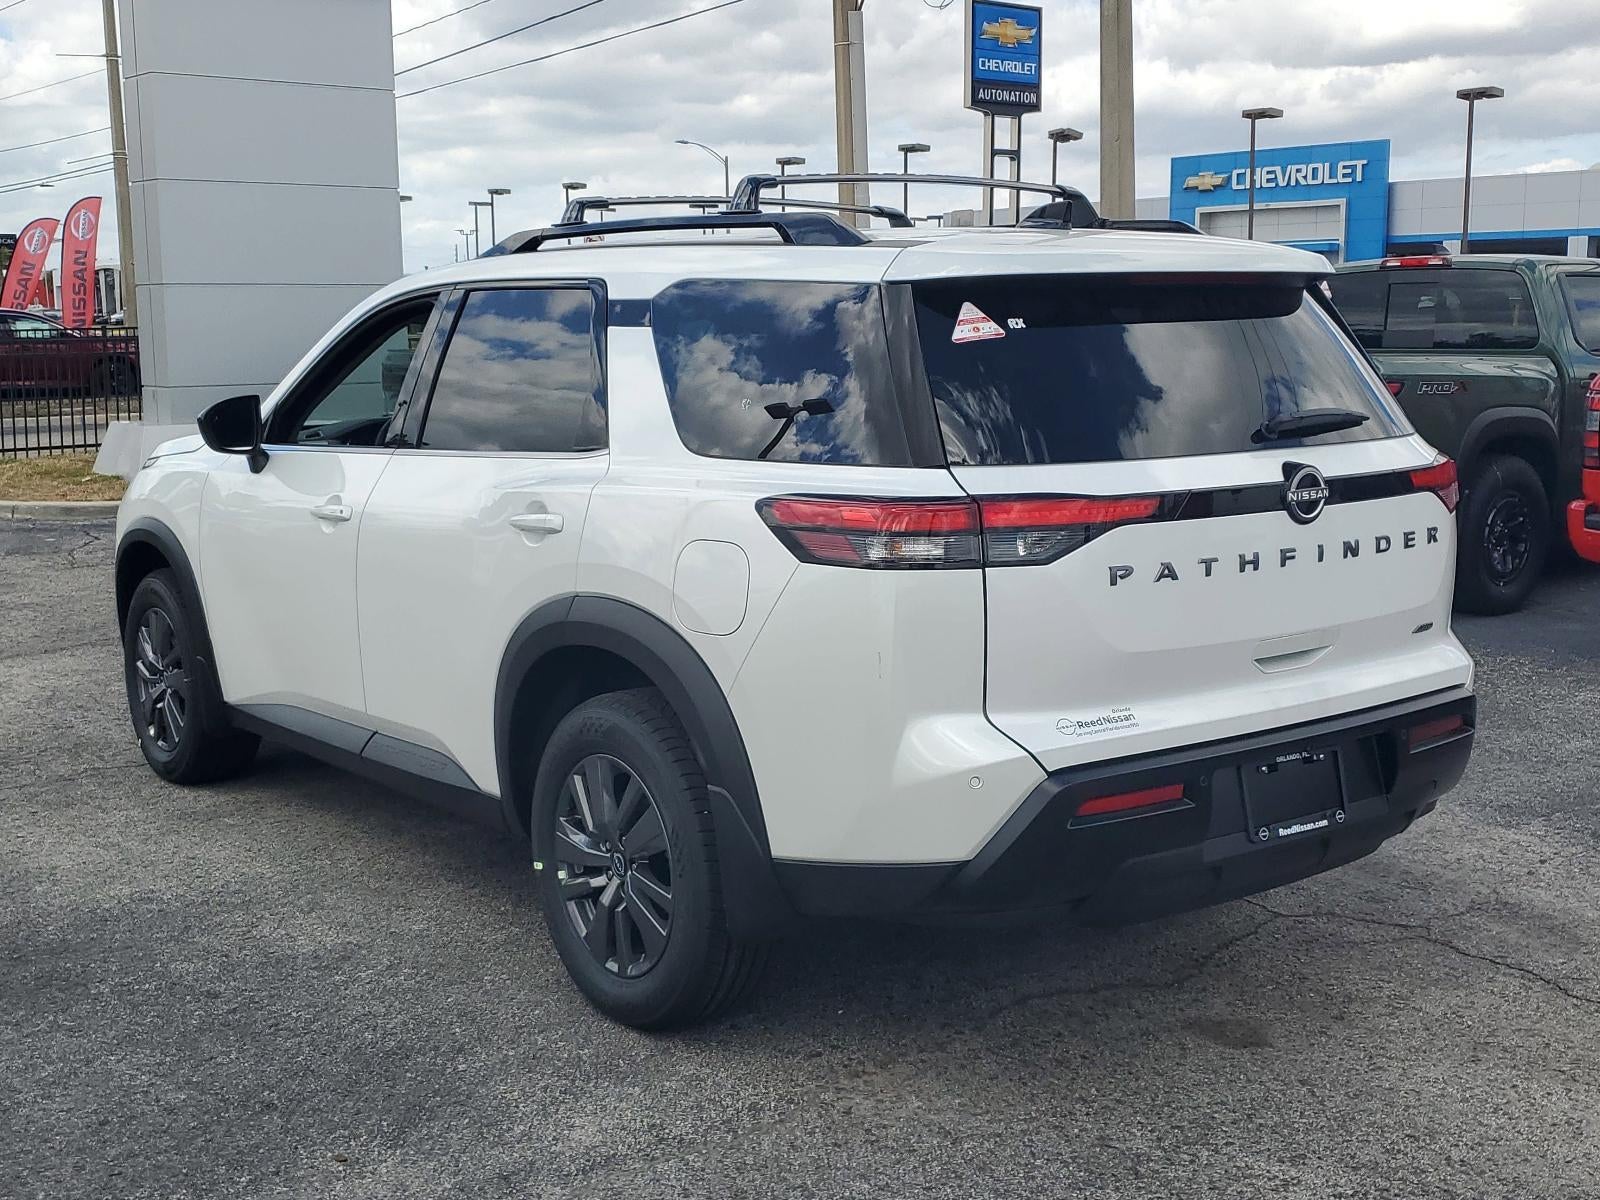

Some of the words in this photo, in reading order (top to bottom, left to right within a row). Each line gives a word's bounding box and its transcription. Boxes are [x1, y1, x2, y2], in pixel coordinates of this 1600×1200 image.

[978, 57, 1037, 75] CHEVROLET
[978, 88, 1037, 104] AUTONATION
[1231, 159, 1368, 190] CHEVROLET
[1288, 489, 1329, 501] NISSAN
[1108, 526, 1439, 587] PATHFINDER
[1278, 819, 1329, 837] ReedNissan.com
